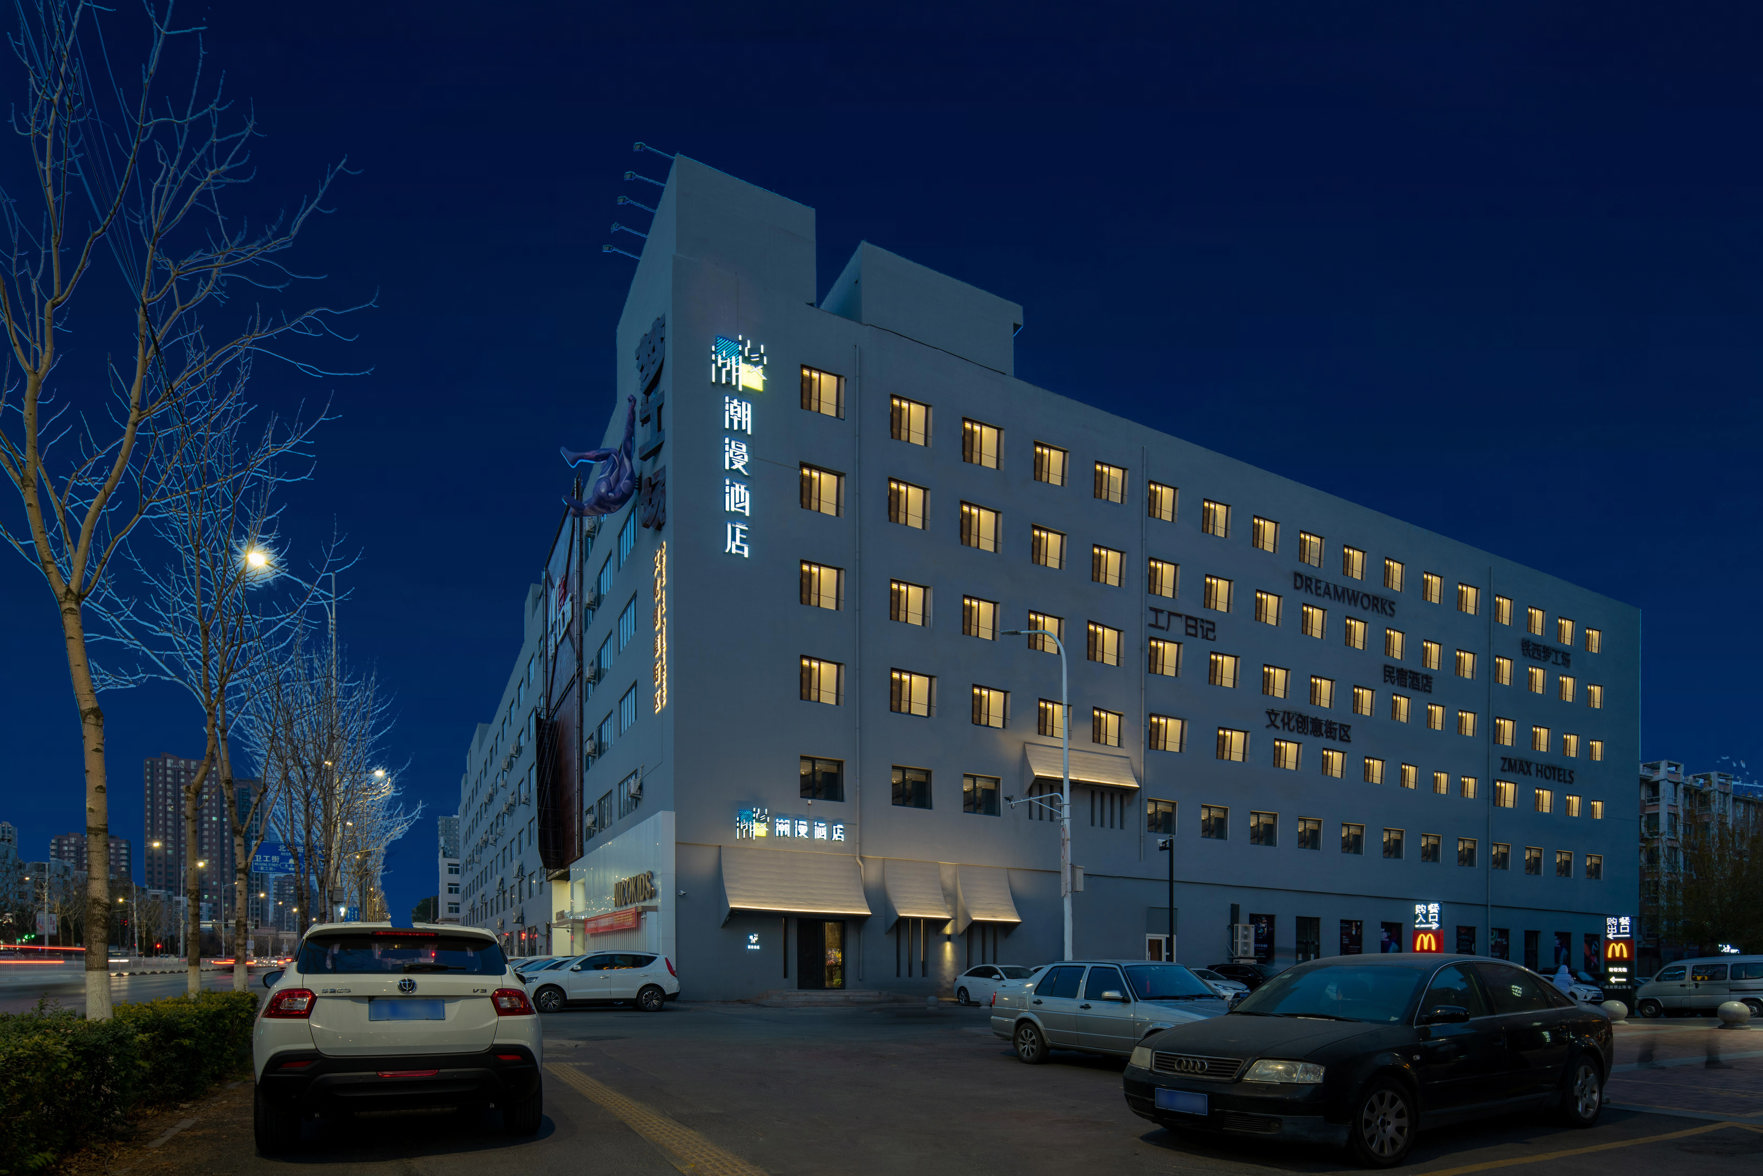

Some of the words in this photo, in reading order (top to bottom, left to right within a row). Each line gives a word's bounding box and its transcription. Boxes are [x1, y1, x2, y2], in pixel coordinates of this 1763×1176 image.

[724, 395, 752, 559] 潮漫酒店
[1293, 571, 1396, 618] DREAMWORKS
[1148, 606, 1217, 642] 工厂日记
[1383, 663, 1433, 694] 民宿酒店
[1265, 708, 1352, 743] 文化创意街区
[1500, 756, 1532, 777] ZMAX
[1535, 762, 1575, 785] HOTELS
[774, 817, 845, 842] 潮漫酒店
[1415, 914, 1439, 923] 入口
